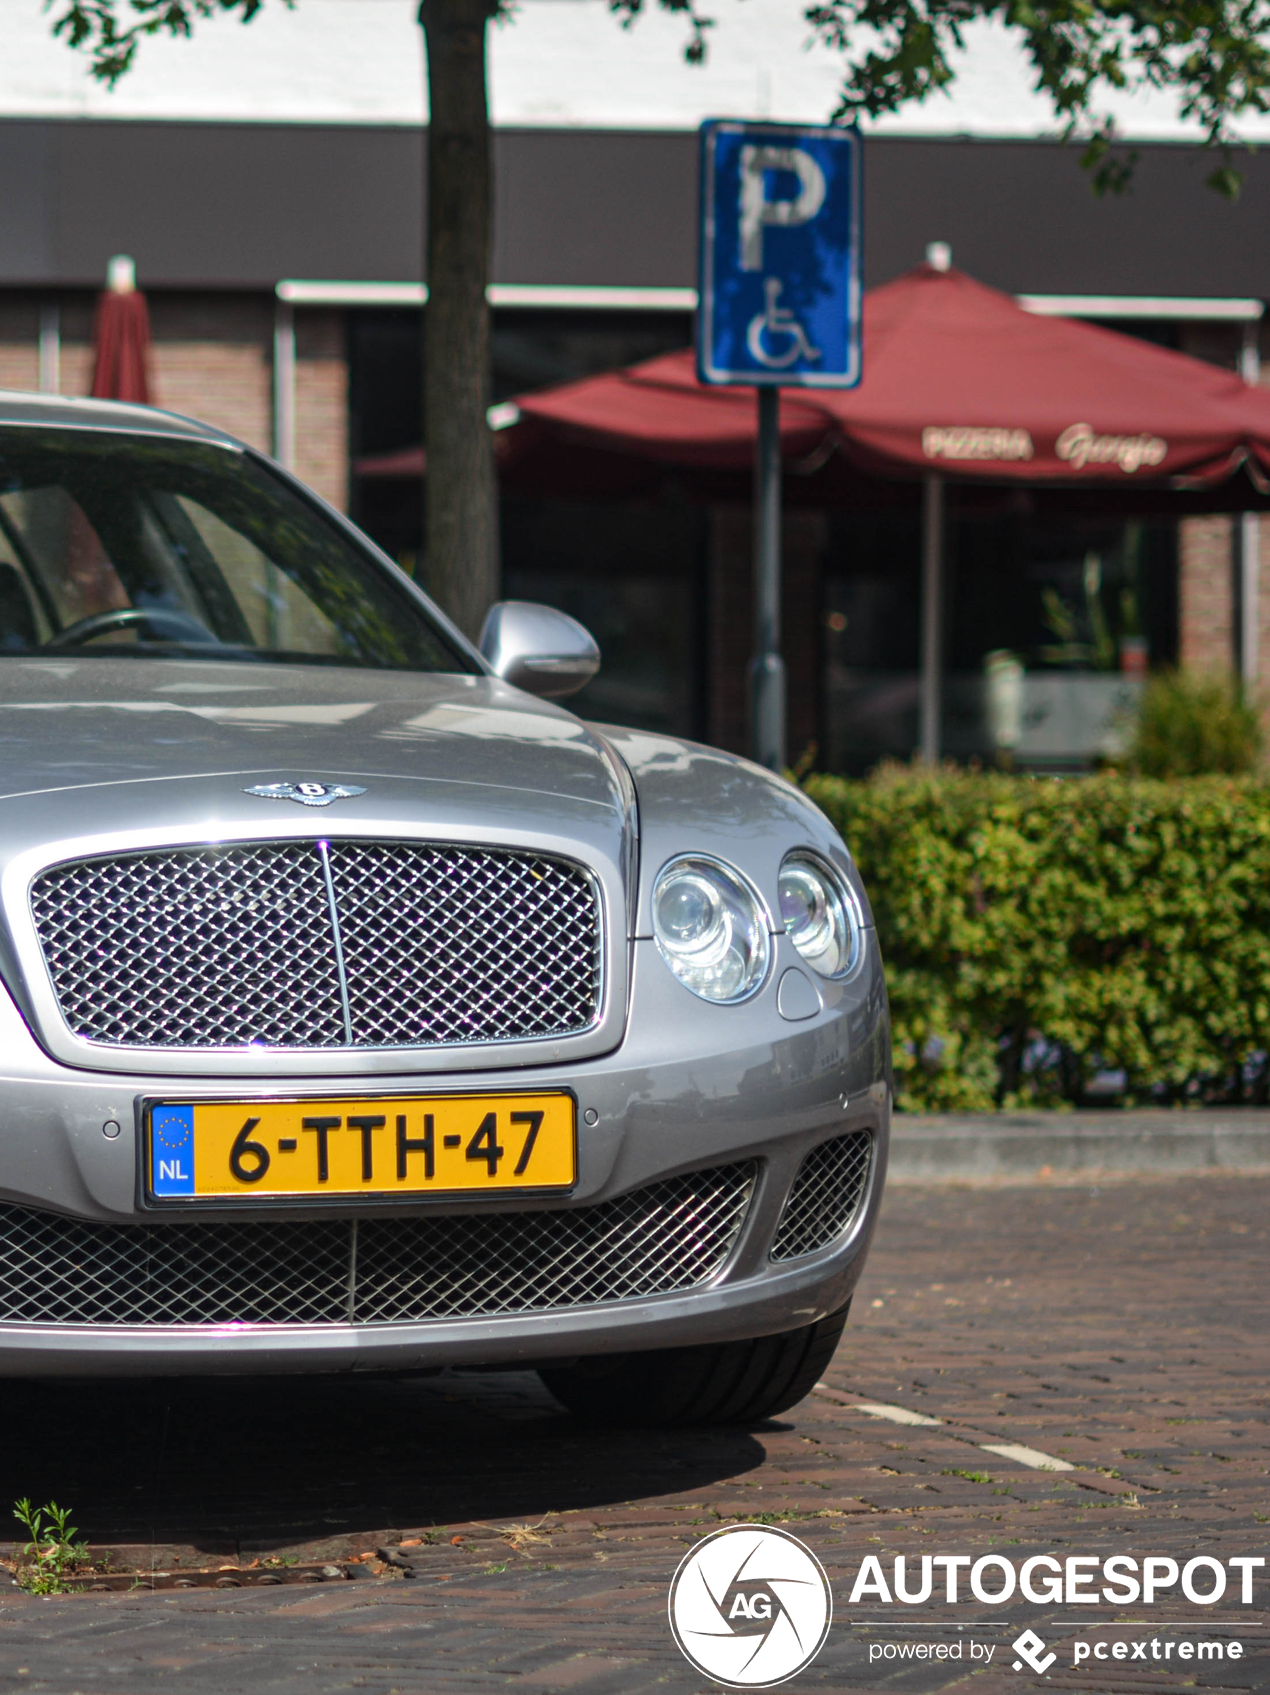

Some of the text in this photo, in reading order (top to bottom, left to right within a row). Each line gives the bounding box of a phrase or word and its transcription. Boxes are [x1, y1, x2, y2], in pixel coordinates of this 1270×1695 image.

[739, 145, 826, 272] P
[922, 426, 1033, 461] PIZZERIA
[298, 783, 326, 797] B
[230, 1110, 545, 1182] 6-TTH-47
[159, 1160, 188, 1180] NL
